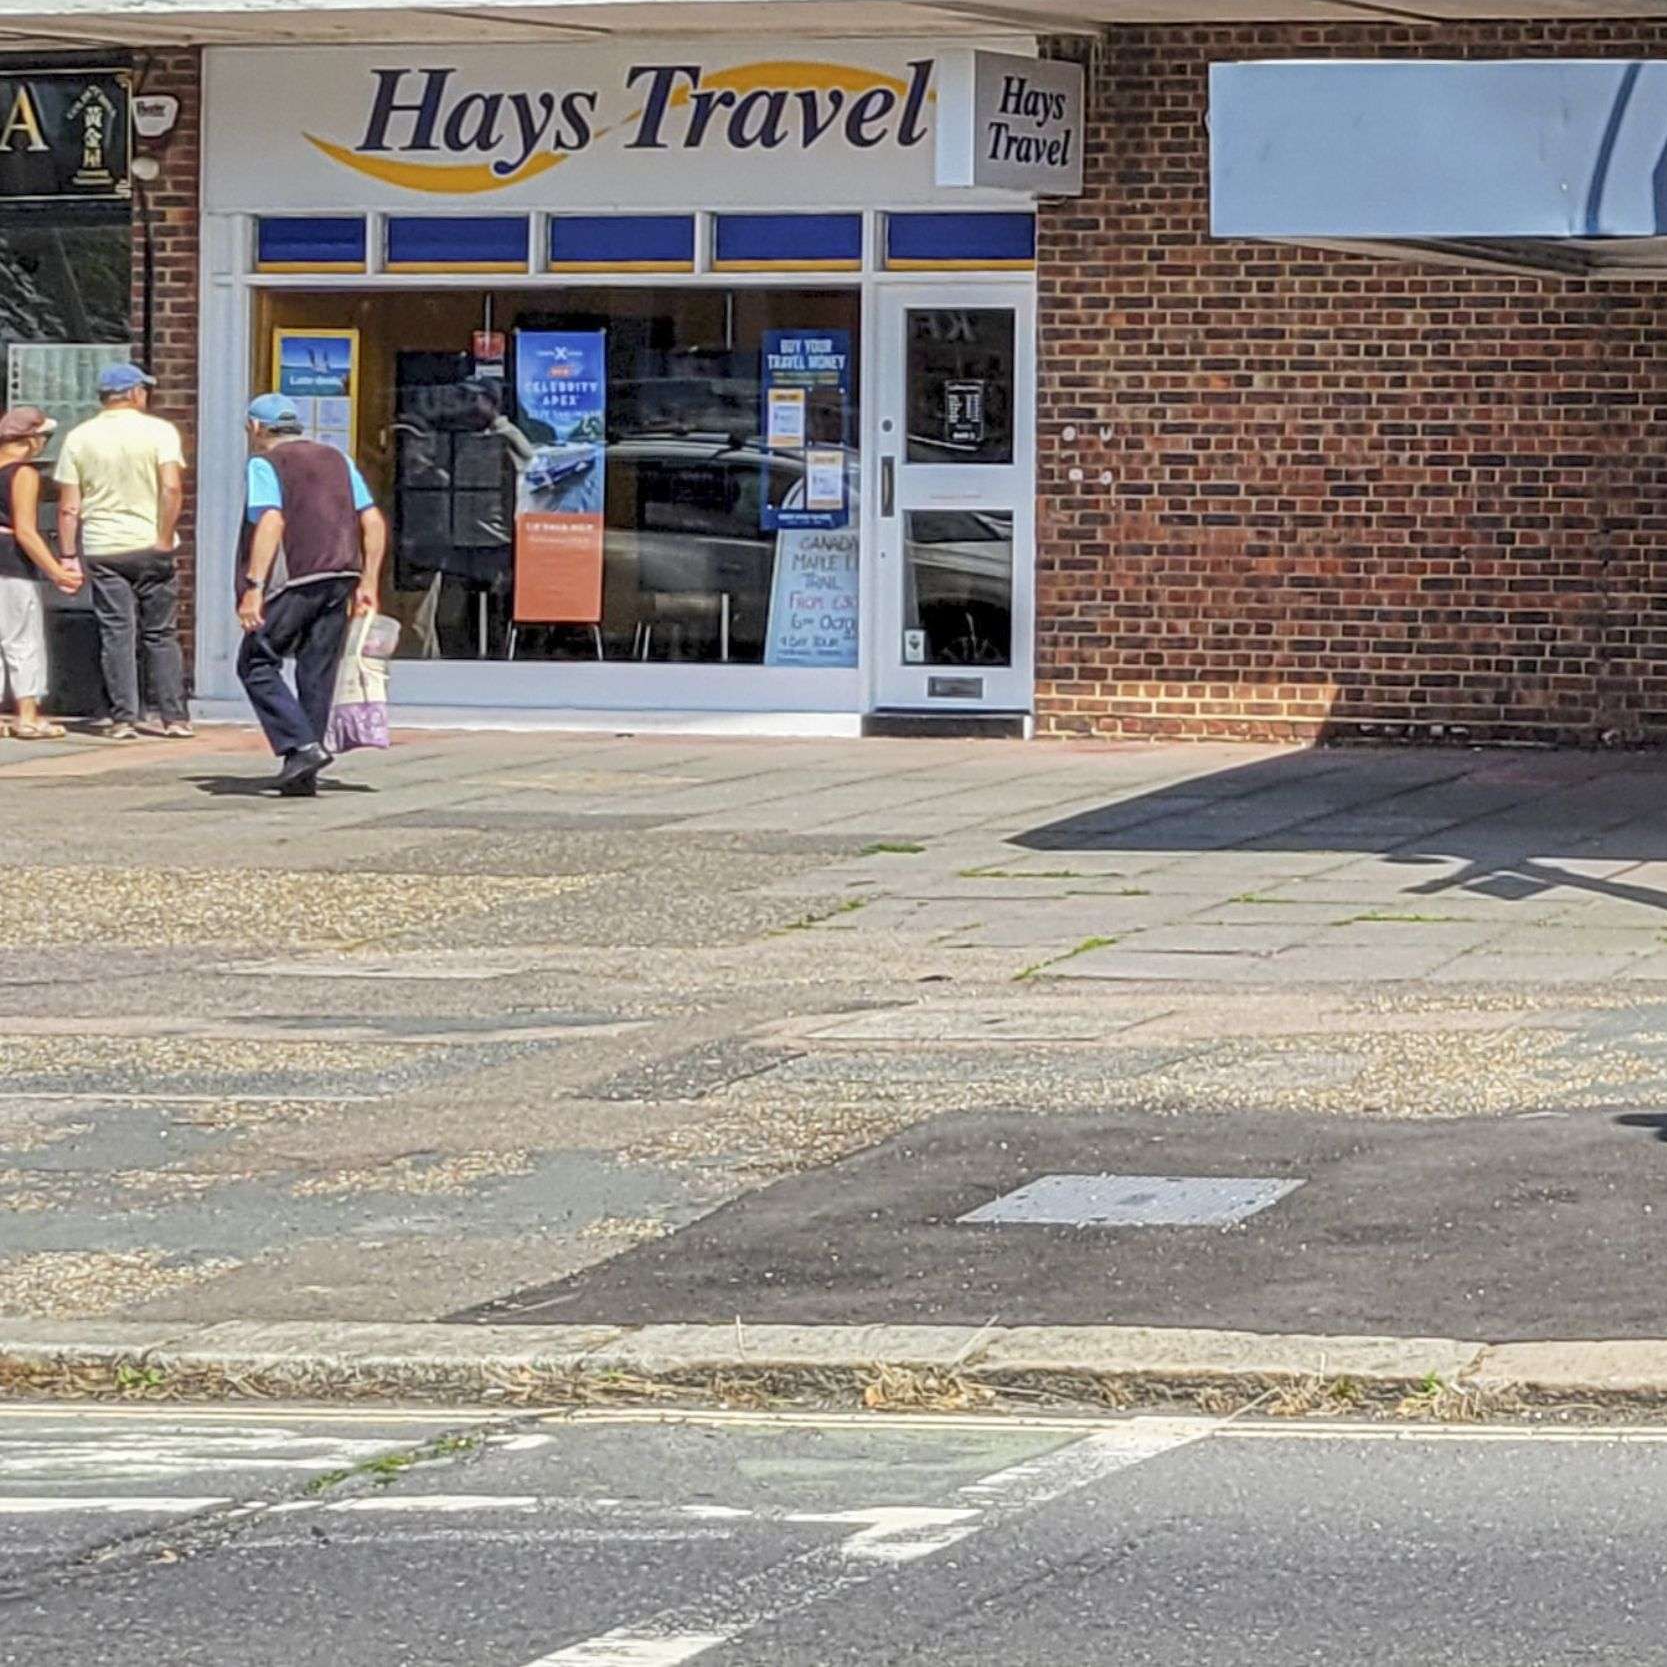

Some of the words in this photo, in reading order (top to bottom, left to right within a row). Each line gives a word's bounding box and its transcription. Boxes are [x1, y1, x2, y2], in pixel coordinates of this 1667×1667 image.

[355, 67, 599, 174] Hays
[623, 59, 935, 150] Travel
[999, 75, 1066, 127] Hays
[988, 121, 1072, 167] Travel
[780, 338, 802, 354] BUY
[804, 338, 833, 354] YOUR
[767, 354, 806, 370] TRAVEL
[808, 354, 846, 370] MONEY
[542, 394, 578, 406] APEX
